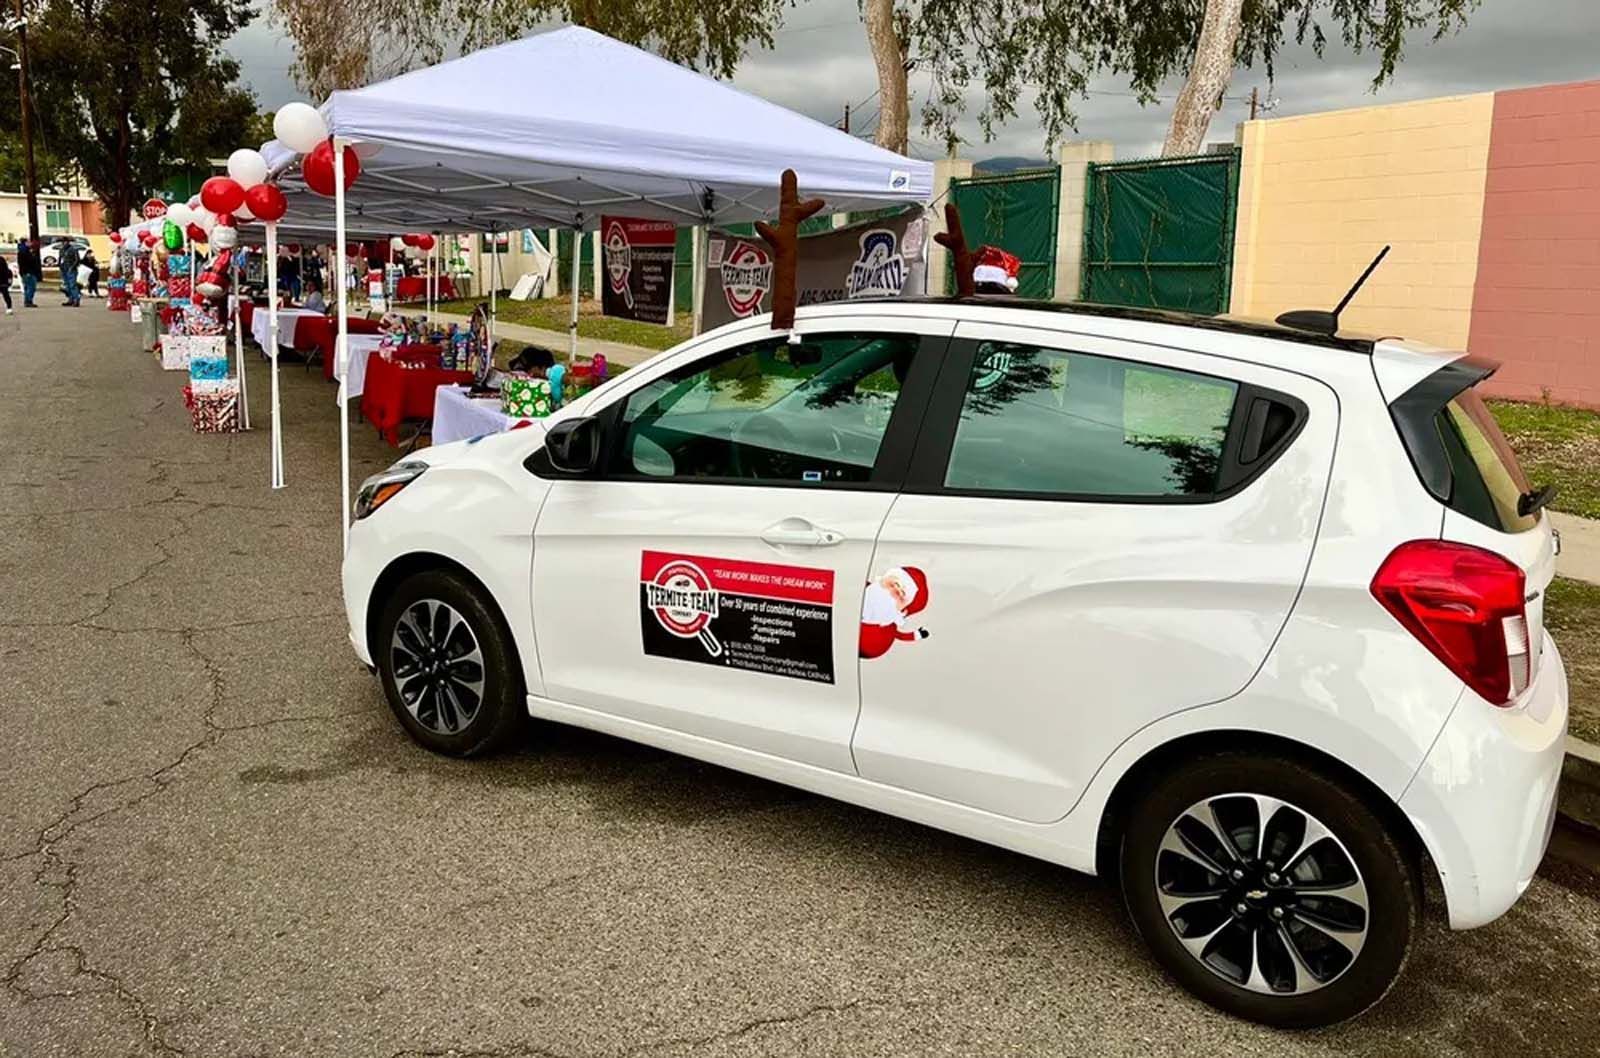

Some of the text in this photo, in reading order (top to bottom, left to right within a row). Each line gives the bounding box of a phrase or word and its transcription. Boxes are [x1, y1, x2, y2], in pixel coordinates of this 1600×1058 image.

[145, 205, 167, 217] STOP
[750, 573, 770, 583] MAKES
[771, 576, 782, 585] THE
[783, 577, 804, 587] DREAM
[720, 597, 735, 607] Over
[742, 602, 758, 612] years
[759, 602, 767, 612] of
[766, 604, 796, 616] combined
[796, 608, 829, 621] experience
